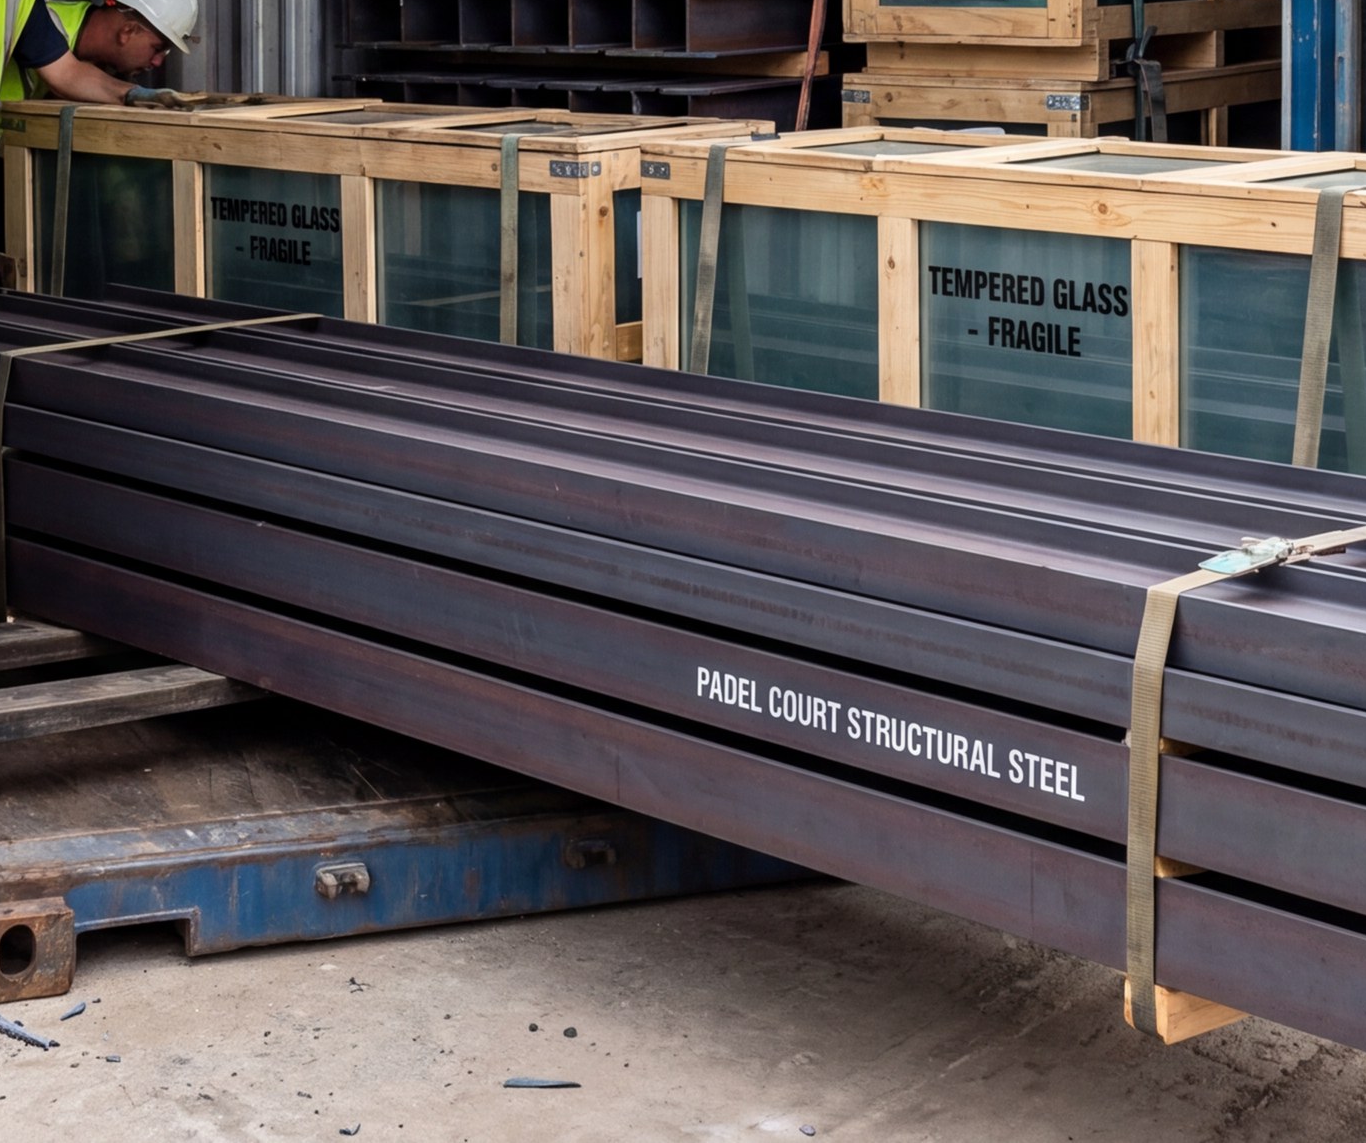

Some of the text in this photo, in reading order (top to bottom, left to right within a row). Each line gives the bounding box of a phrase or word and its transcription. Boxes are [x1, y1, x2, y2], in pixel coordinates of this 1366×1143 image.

[210, 197, 340, 233] TEMPERED GLASS
[249, 235, 312, 266] FRAGILE
[928, 265, 1129, 317] TEMPERED GLASS
[988, 316, 1082, 357] FRAGILE
[696, 666, 1085, 802] PADEL COURT STRUCTURAL STEEL
